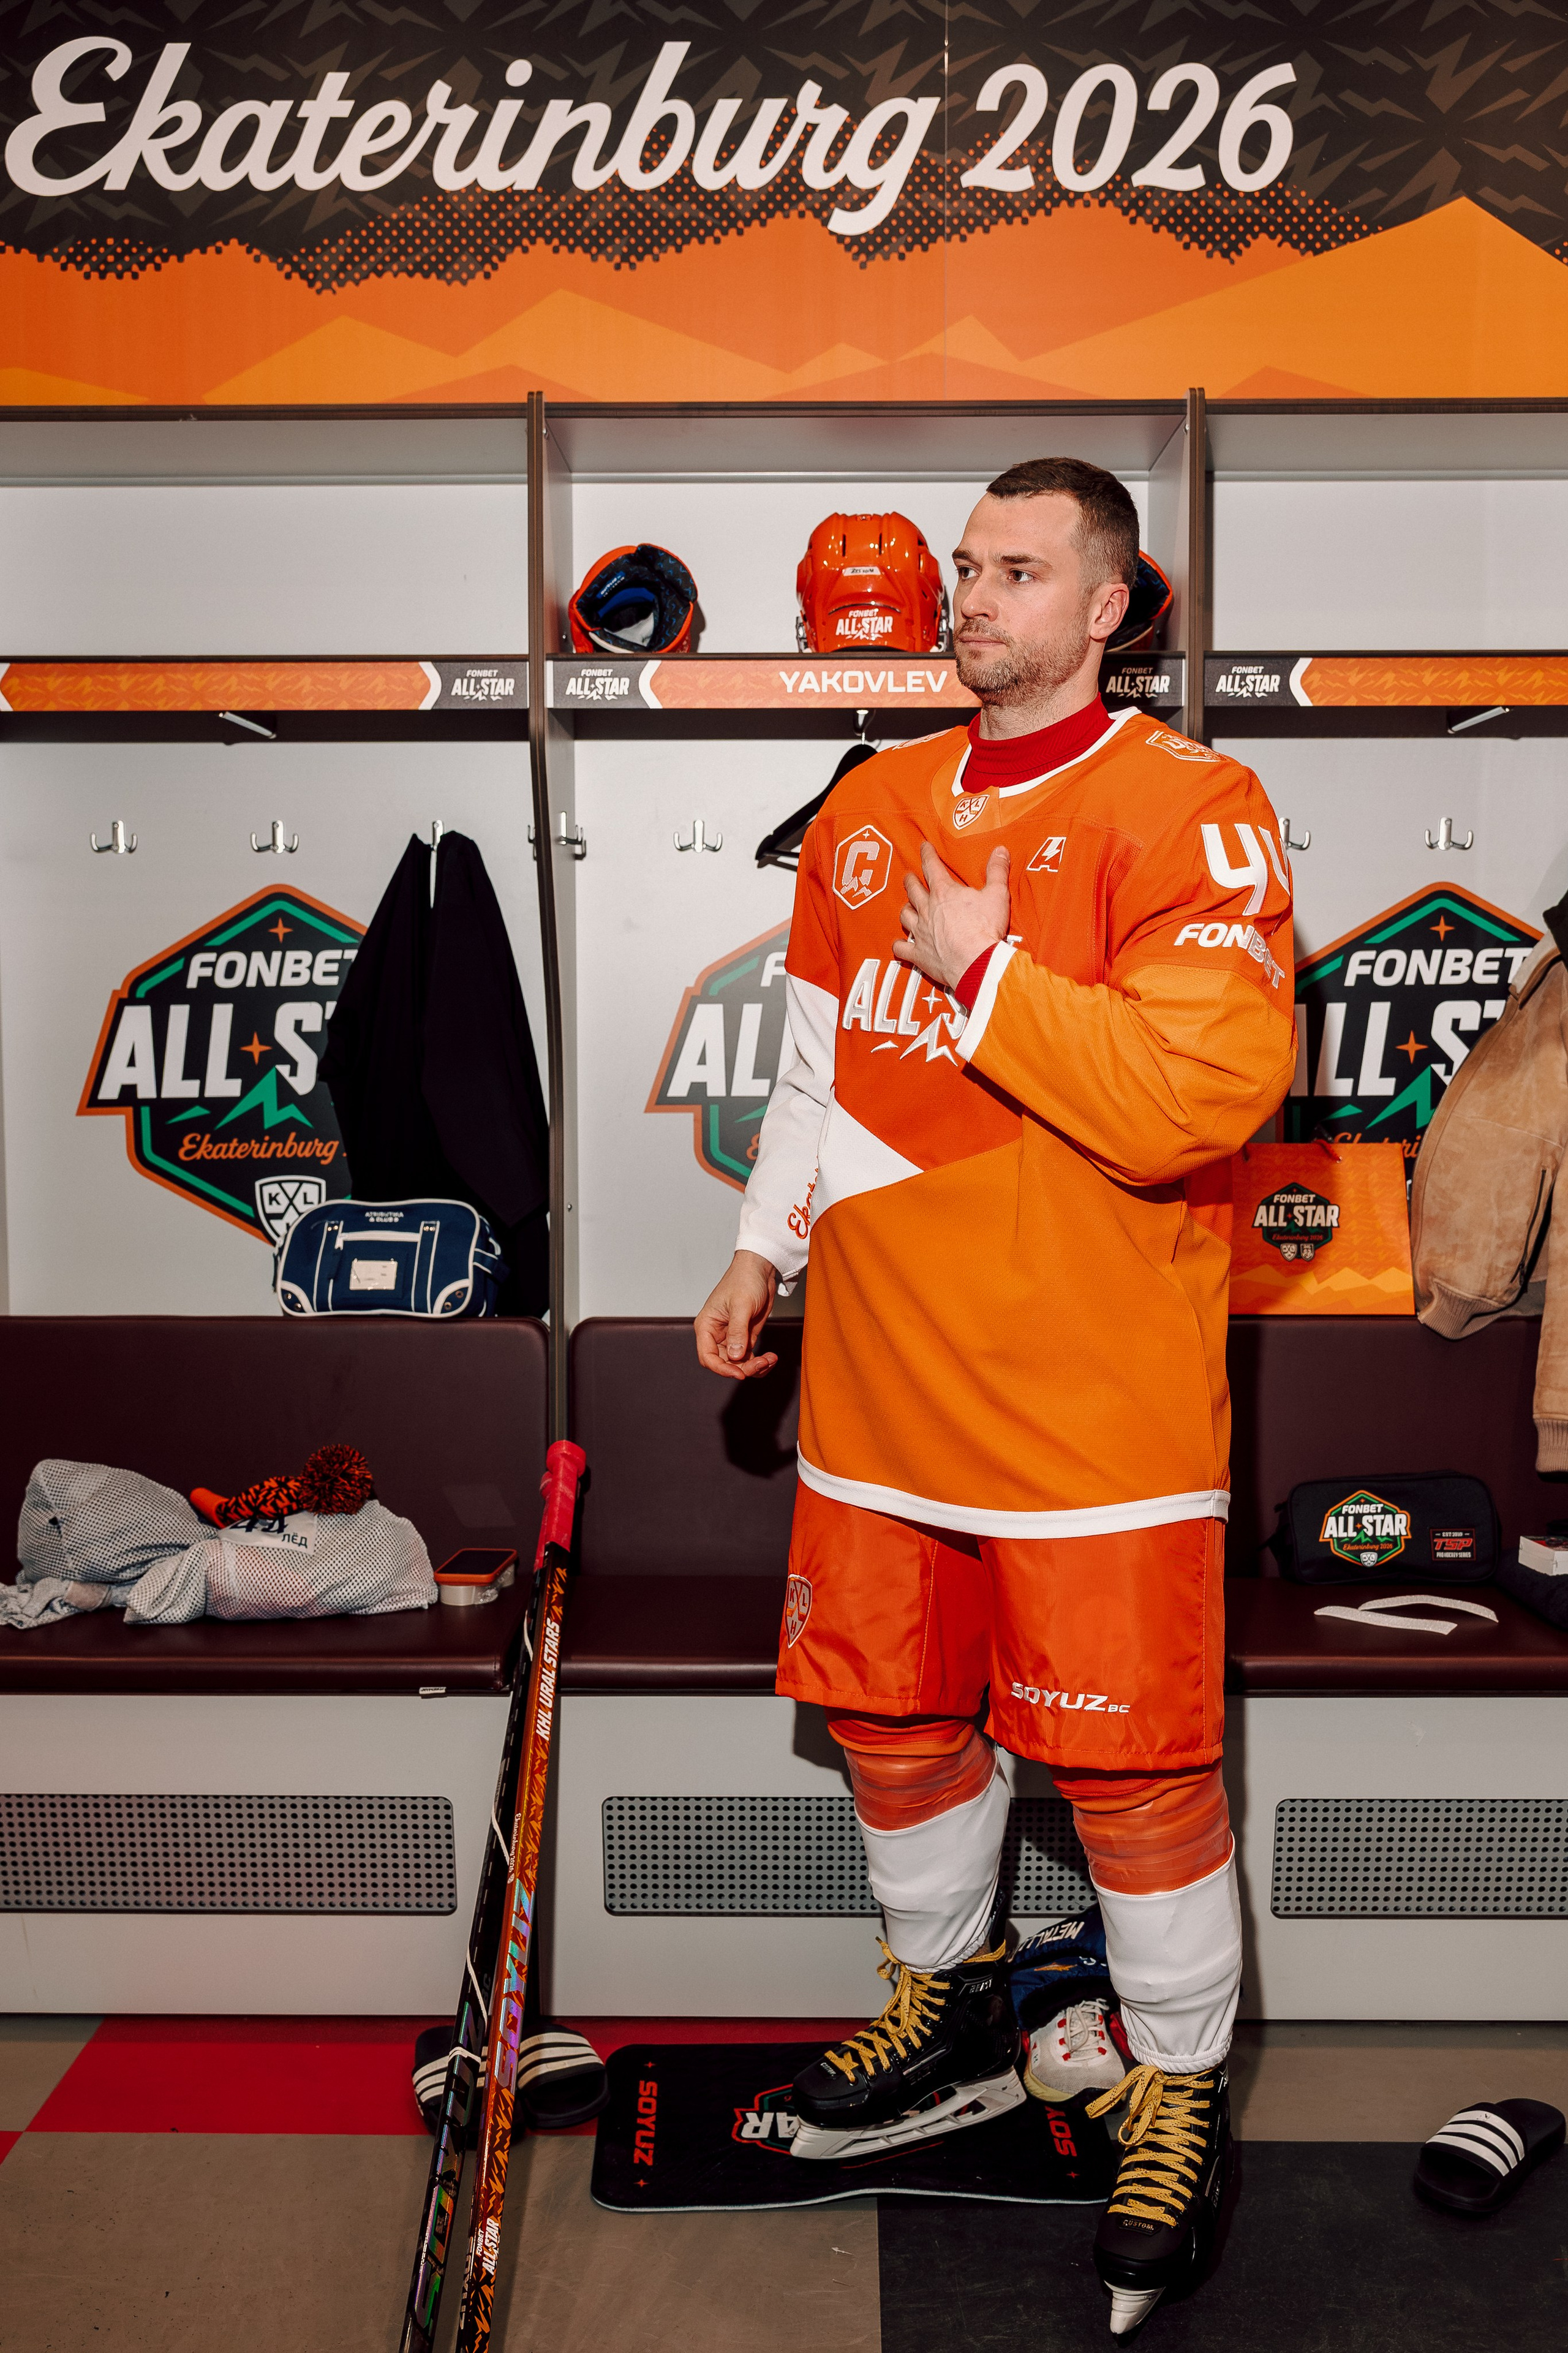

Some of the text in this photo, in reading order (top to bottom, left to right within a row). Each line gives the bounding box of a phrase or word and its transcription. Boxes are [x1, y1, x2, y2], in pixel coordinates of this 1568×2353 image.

[5, 36, 1297, 236] Ekaterinburg 2026
[835, 616, 893, 635] ALL STAR
[848, 608, 878, 618] FONBET
[581, 668, 613, 677] FONBET
[779, 671, 948, 693] YAKOVLEV
[1106, 674, 1170, 693] ALL STAR
[1215, 674, 1281, 693] ALL STAR
[451, 678, 515, 696] ALL STAR
[565, 677, 630, 695] ALL STAR
[1174, 922, 1285, 989] FONBET
[1344, 947, 1534, 988] FONBET
[186, 949, 358, 989] FONBE
[842, 958, 924, 1034] ALL
[97, 1003, 242, 1100] ALL
[178, 1132, 340, 1165] Ekaterinburg
[1273, 1194, 1316, 1204] FONBET
[1253, 1204, 1340, 1227] ALL STAR
[1342, 1503, 1384, 1514] FONBET
[1324, 1514, 1408, 1538] ALL STAR
[282, 1532, 307, 1549] ЛЁД
[1433, 1538, 1473, 1550] TSP
[536, 1617, 560, 1741] KHL URAL STARS
[1011, 1681, 1131, 1714] SOYUZ BC
[510, 1812, 521, 1856] Ekaterinburg
[633, 2080, 658, 2167] SOYUZ
[741, 2112, 799, 2139] AR
[1045, 2106, 1078, 2158] SOY
[1121, 2218, 1155, 2231] CUSTOM
[476, 2228, 484, 2256] FONBET
[482, 2217, 499, 2276] ALL STAR
